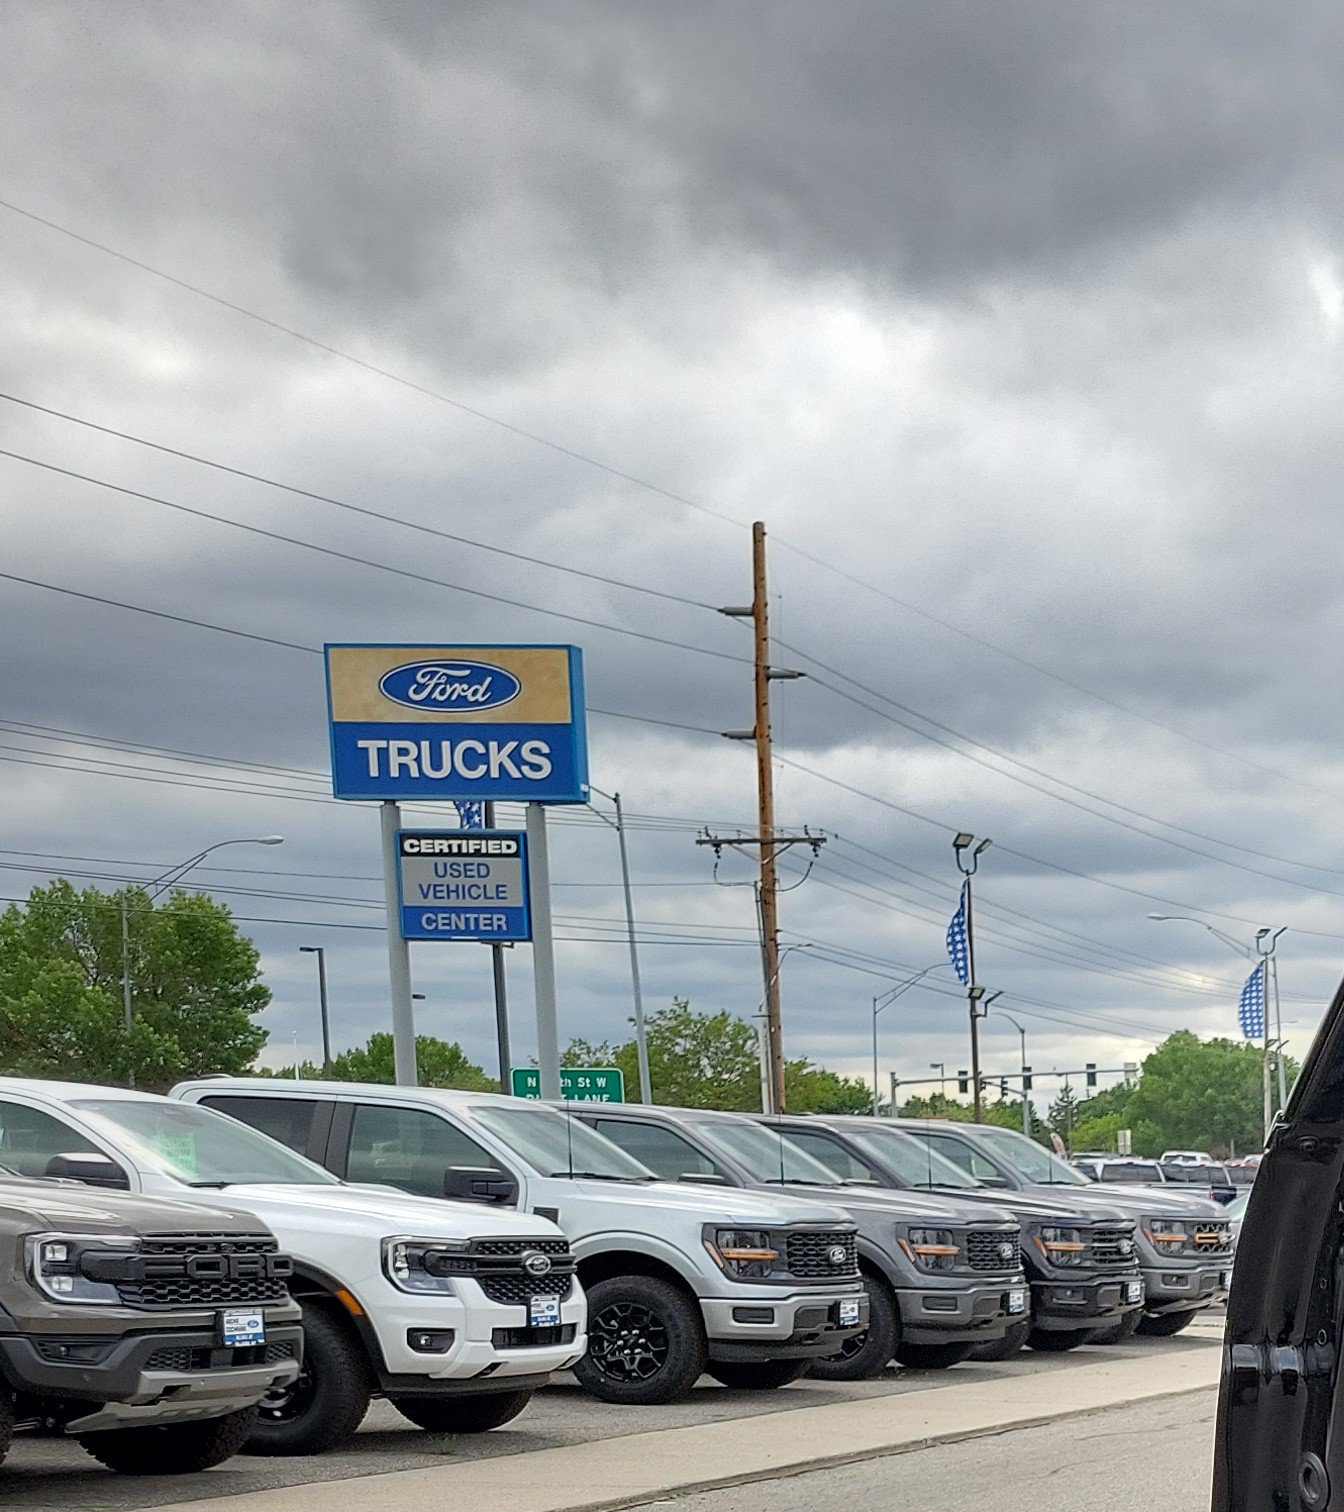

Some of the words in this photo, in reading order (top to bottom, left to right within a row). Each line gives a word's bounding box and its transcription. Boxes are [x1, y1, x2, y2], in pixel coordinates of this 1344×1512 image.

[408, 666, 493, 703] Ford
[357, 740, 552, 780] TRUCKS
[403, 838, 518, 855] CERTIFIED
[434, 862, 490, 879] USED
[419, 883, 508, 901] VEHICLE
[421, 913, 508, 931] CENTER
[526, 1076, 537, 1088] N
[577, 1077, 591, 1088] St
[596, 1077, 607, 1088] W
